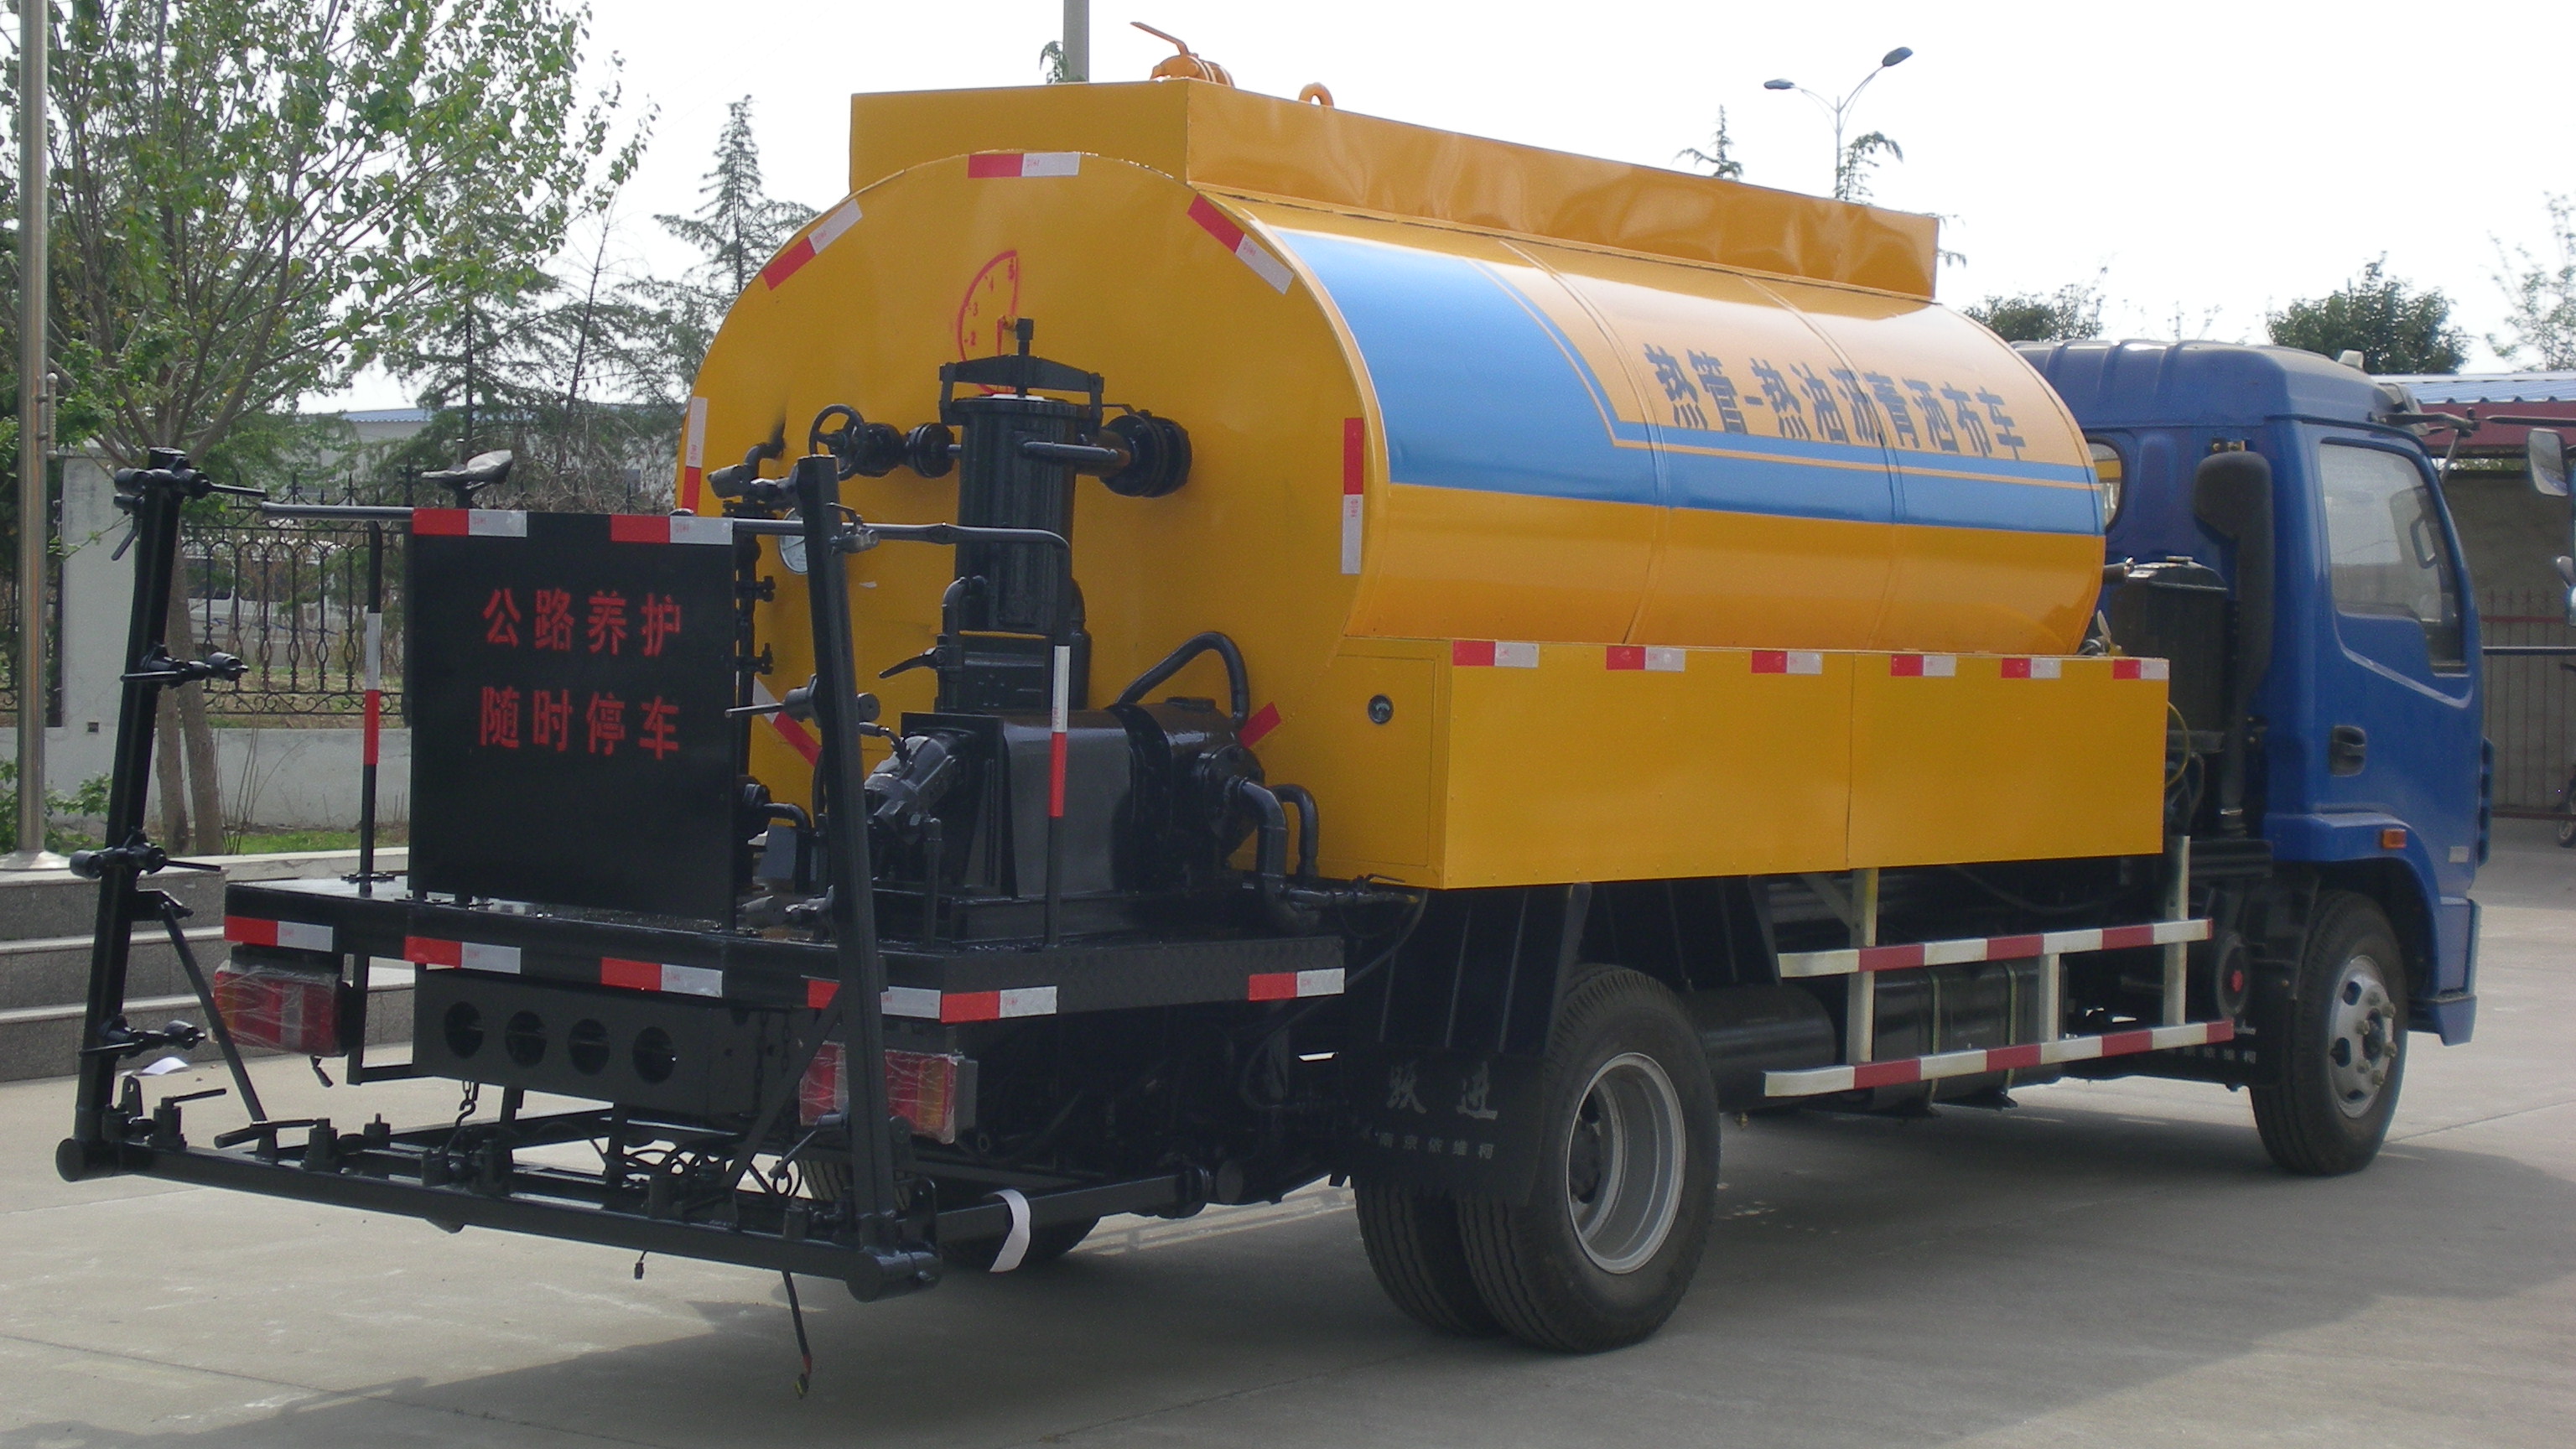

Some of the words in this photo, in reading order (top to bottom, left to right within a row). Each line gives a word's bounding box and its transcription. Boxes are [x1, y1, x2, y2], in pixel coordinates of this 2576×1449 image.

[482, 588, 682, 657] 公路养护
[479, 685, 681, 761] 随时停车
